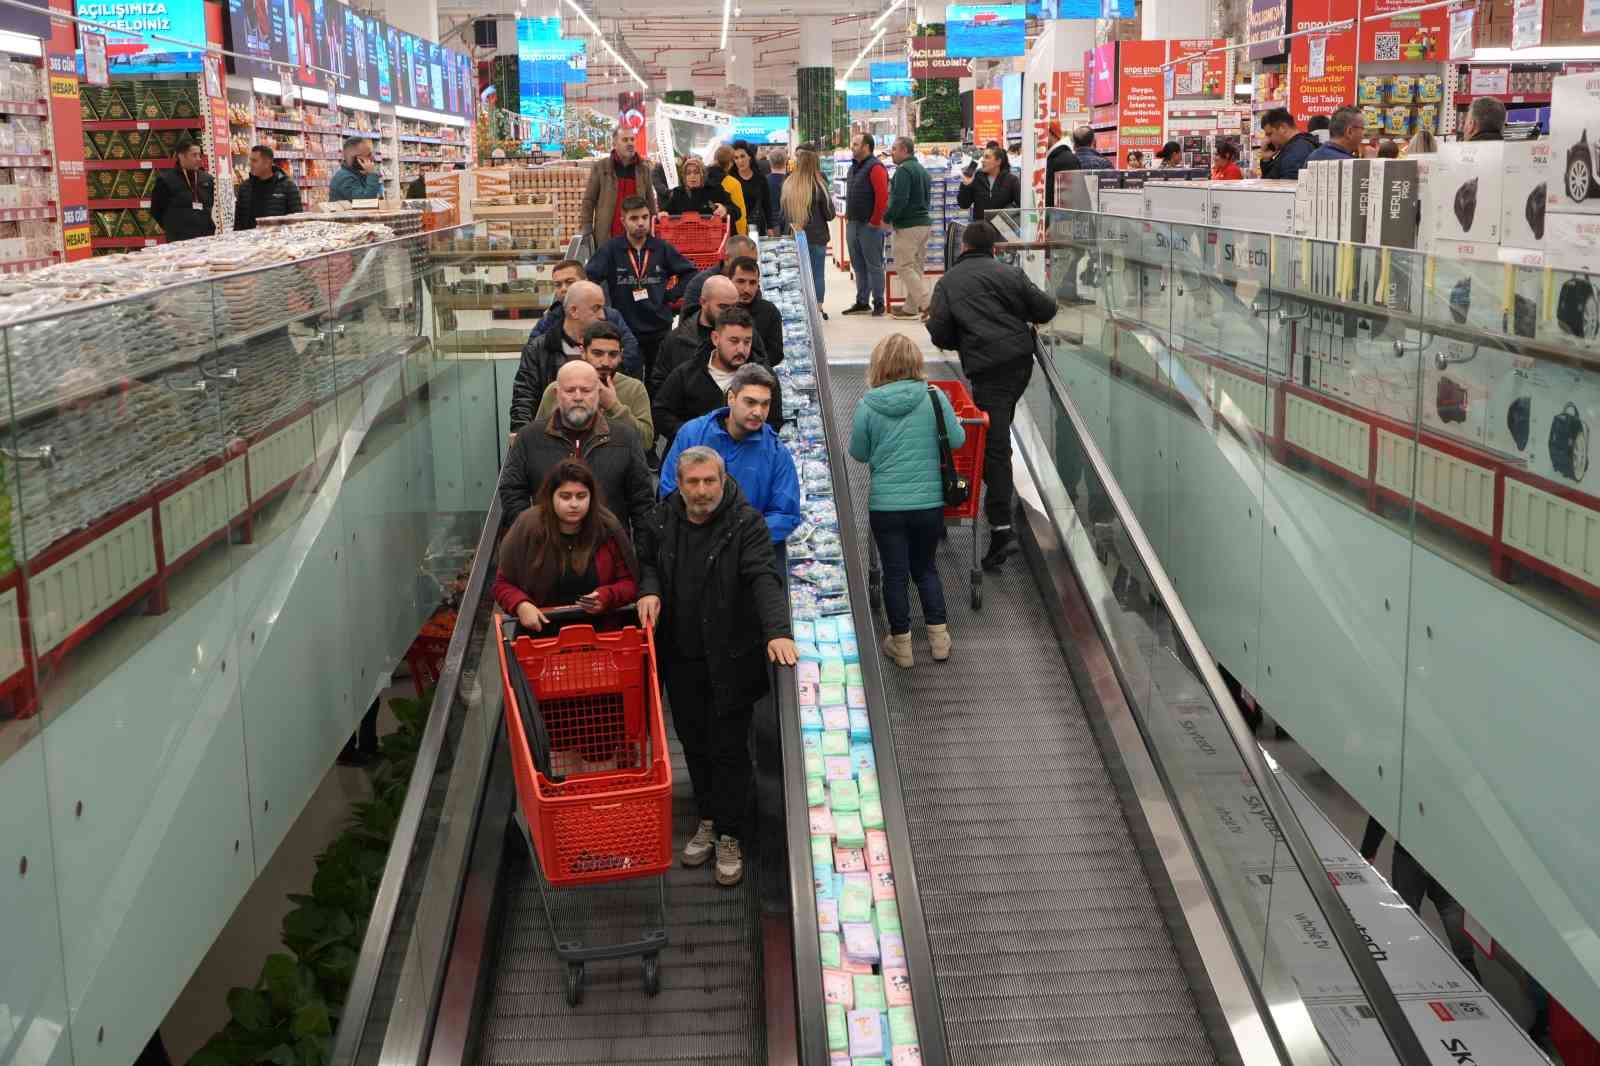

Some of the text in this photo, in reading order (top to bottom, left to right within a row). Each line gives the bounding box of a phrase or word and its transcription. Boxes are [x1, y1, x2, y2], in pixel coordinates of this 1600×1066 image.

[78, 3, 167, 19] AÇILIŞIMIZA
[1300, 84, 1328, 93] Olmak
[1302, 95, 1344, 104] Bizi Takip
[1402, 180, 1410, 199] PRO
[1391, 180, 1401, 219] MERLIN
[1441, 1038, 1478, 1066] Sk
